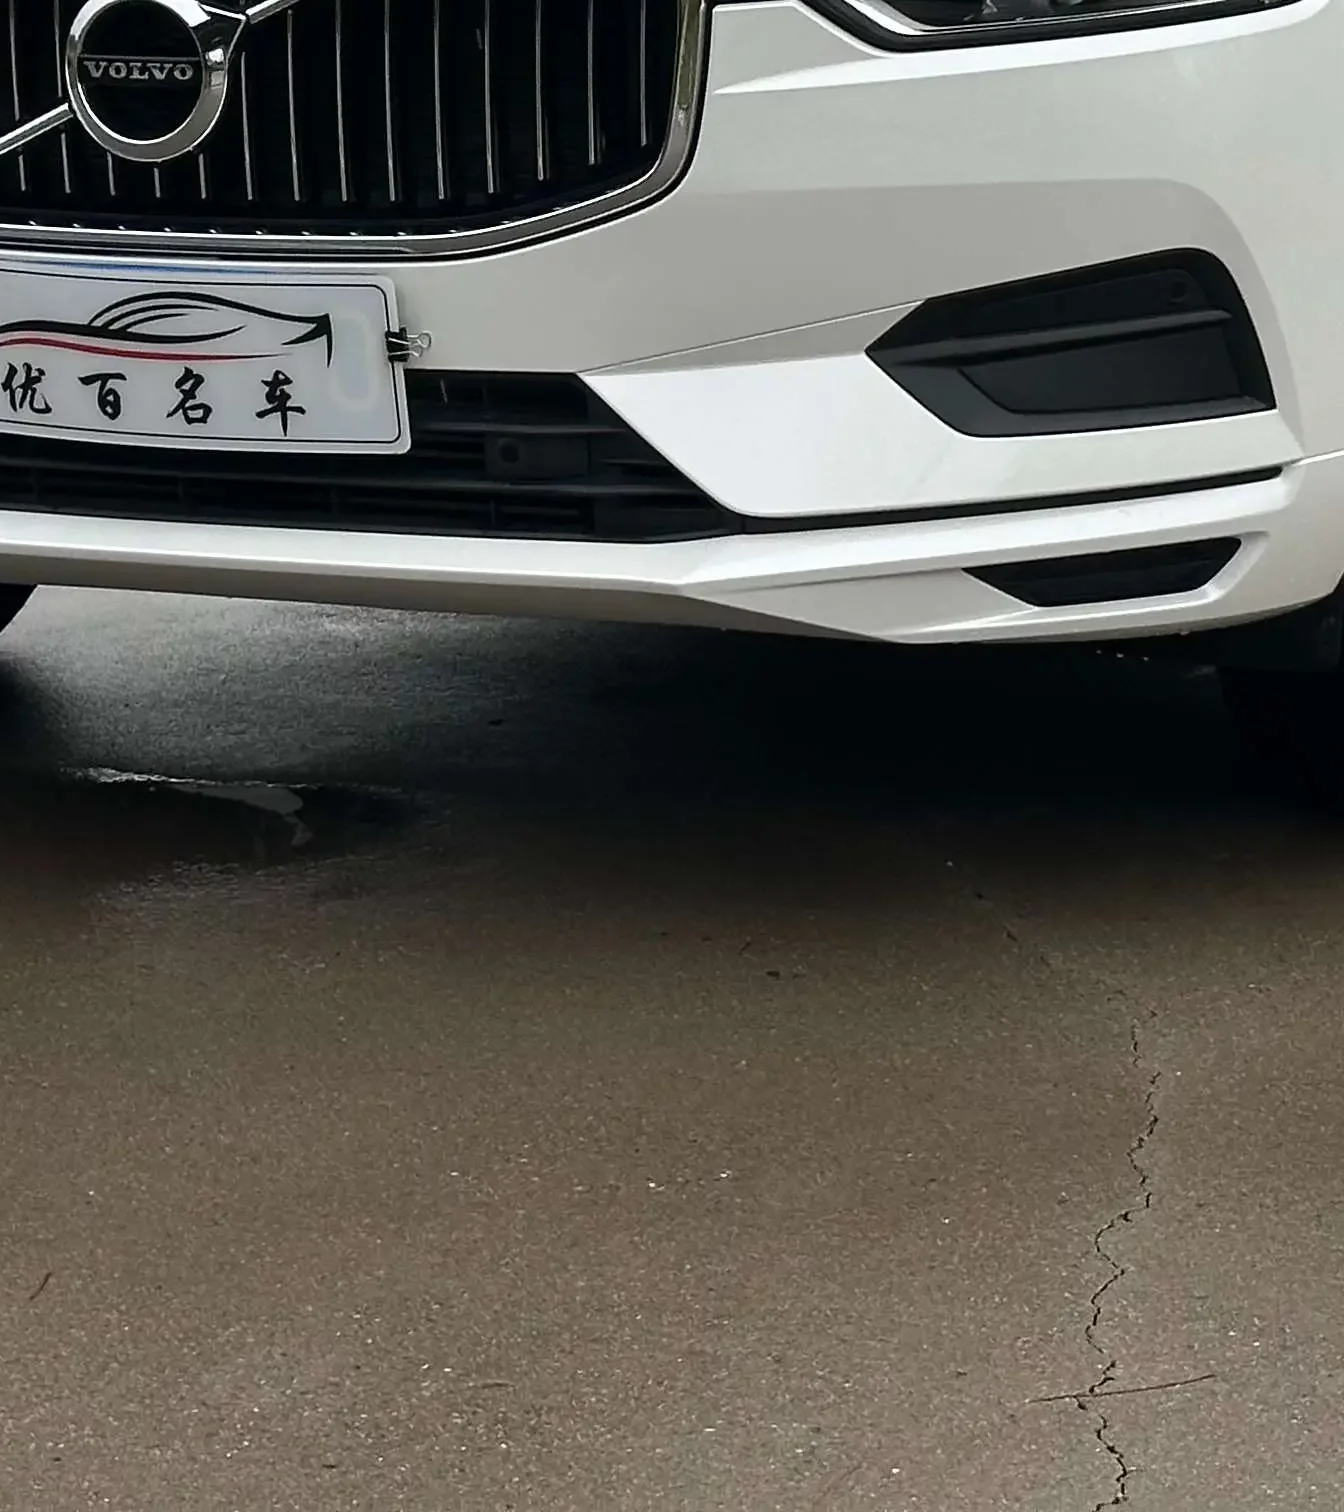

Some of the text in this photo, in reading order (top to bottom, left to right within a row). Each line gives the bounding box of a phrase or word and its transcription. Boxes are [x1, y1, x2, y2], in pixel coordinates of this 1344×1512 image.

[83, 60, 194, 80] VOLVO
[0, 361, 307, 437] 优百名车
